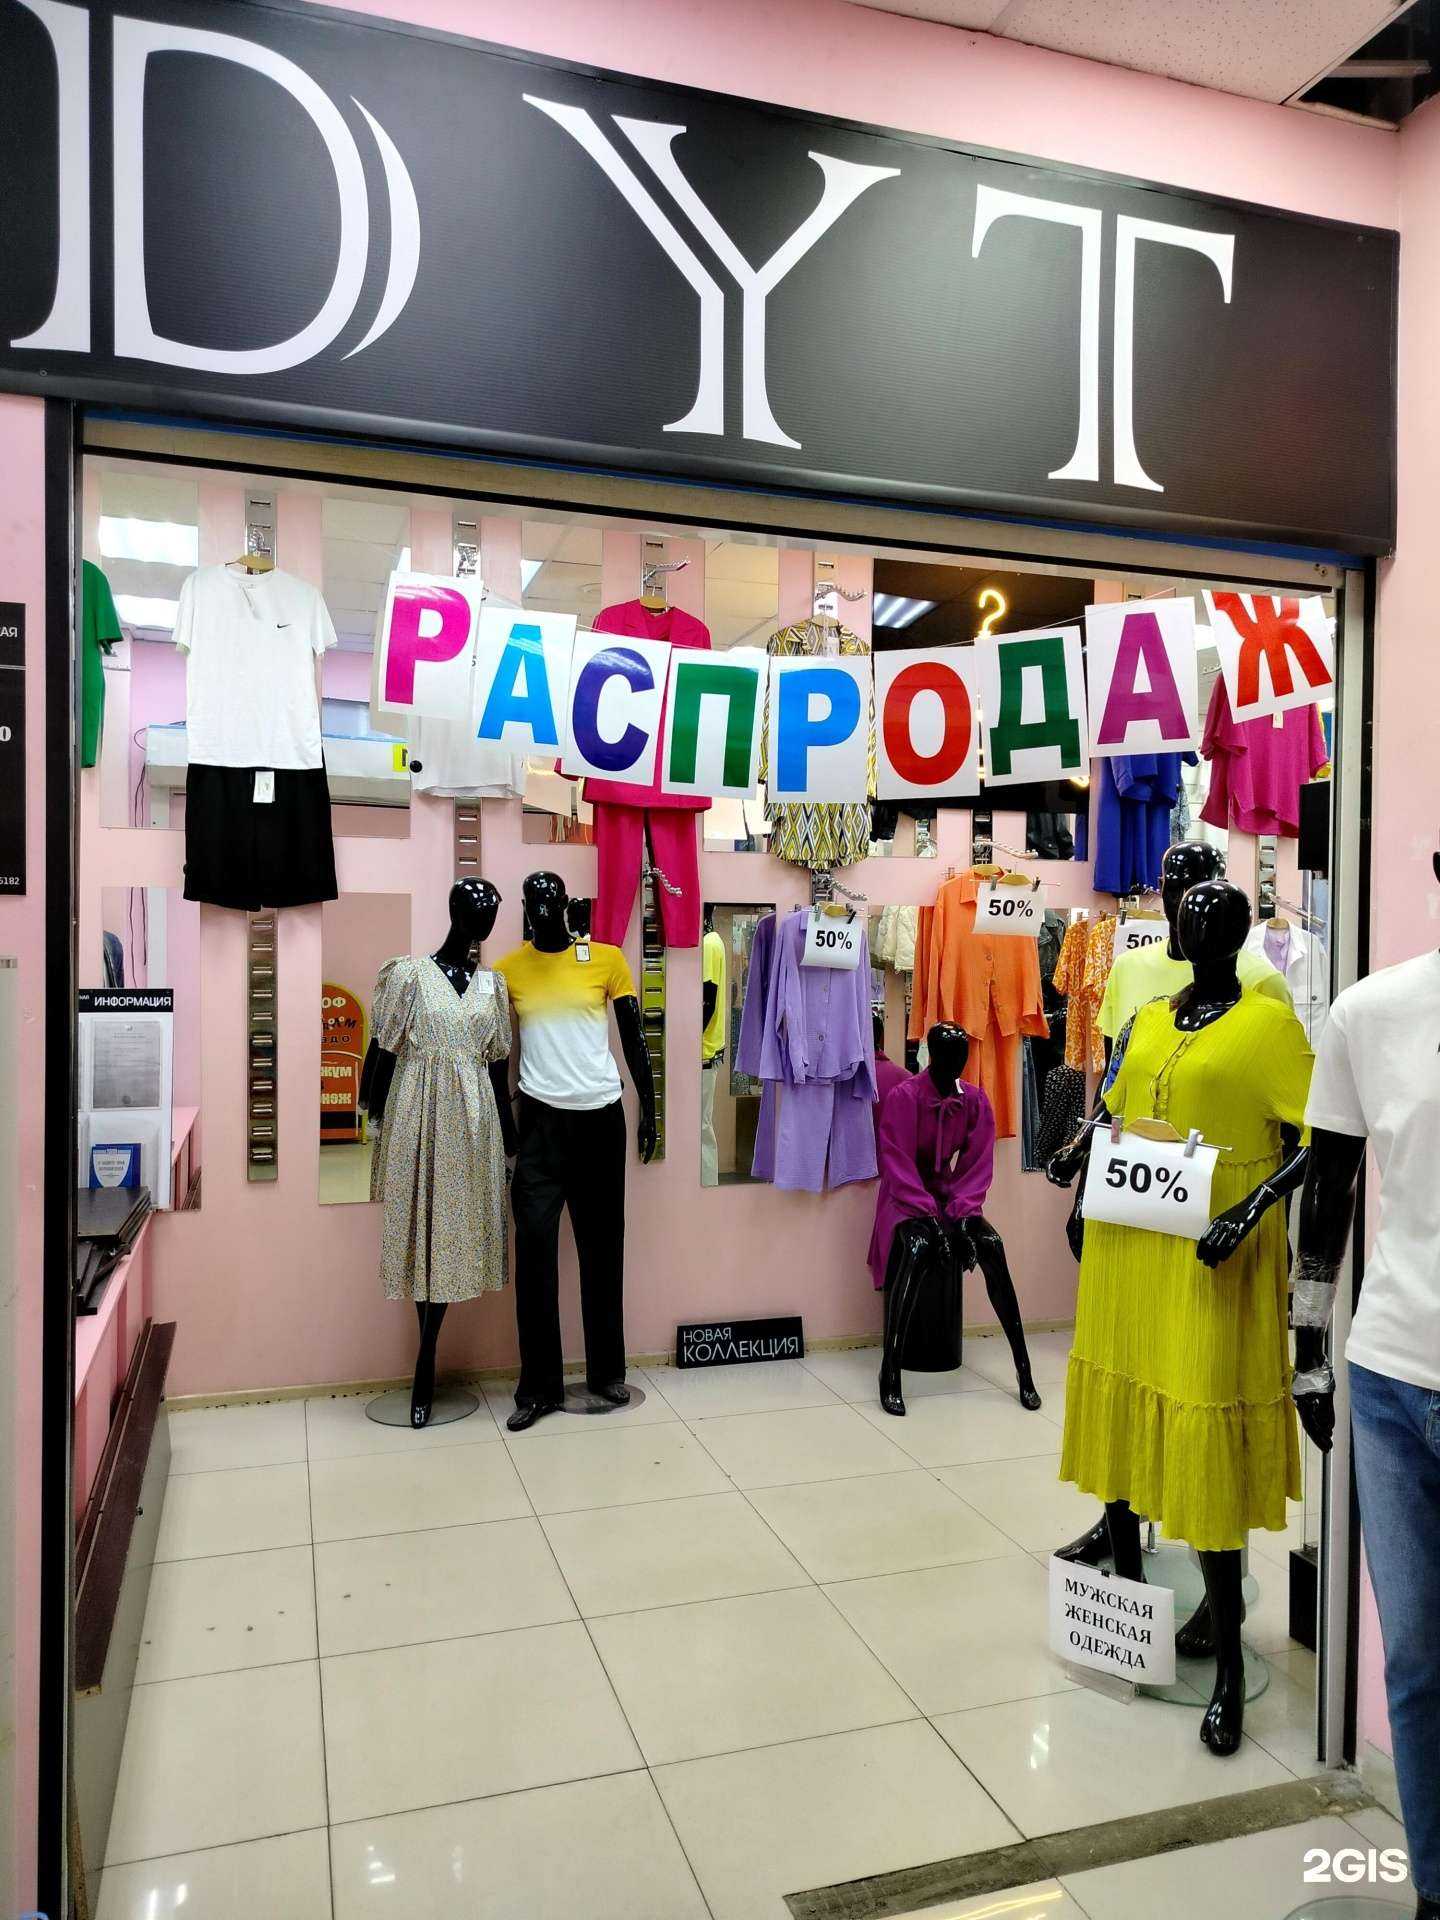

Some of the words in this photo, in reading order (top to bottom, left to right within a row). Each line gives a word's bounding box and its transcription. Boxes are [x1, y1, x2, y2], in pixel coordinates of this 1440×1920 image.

[0, 626, 18, 638] АЯ
[988, 899, 1033, 917] 50%
[815, 930, 852, 949] 50%
[94, 996, 171, 1008] ИНФОРМАЦИЯ
[1105, 1157, 1188, 1203] 50%
[683, 1327, 732, 1343] НОВАЯ
[683, 1336, 799, 1362] КОЛЛЕКЦИЯ
[1064, 1577, 1153, 1620] МУЖСКАЯ
[1064, 1602, 1152, 1645] ЖЕНСКАЯ
[1069, 1630, 1146, 1670] ОДЕЖДА
